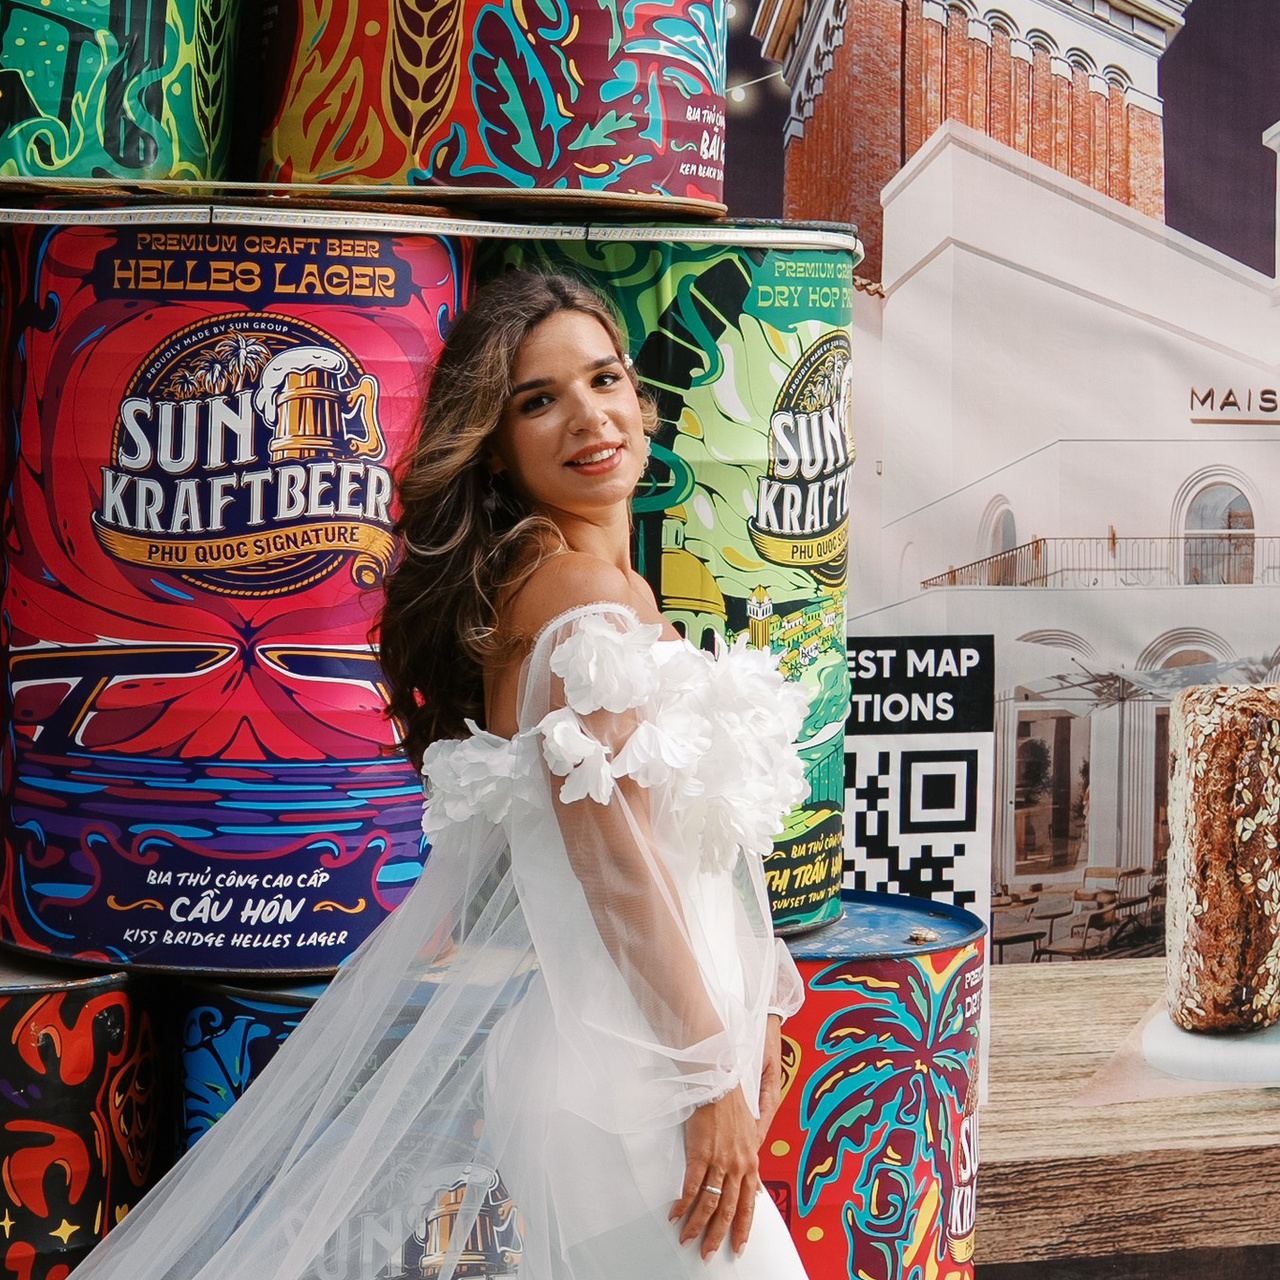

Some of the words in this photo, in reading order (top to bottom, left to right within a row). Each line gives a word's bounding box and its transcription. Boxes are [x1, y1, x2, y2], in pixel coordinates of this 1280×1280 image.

[686, 105, 700, 122] BIA
[680, 163, 697, 176] KEM
[137, 233, 238, 253] PREMIUM
[244, 235, 319, 256] CRAFT
[326, 237, 381, 259] BEER
[113, 259, 262, 293] HELLES
[273, 263, 397, 299] LAGER
[774, 262, 834, 278] PREMIUM
[757, 285, 803, 308] DRY
[808, 286, 840, 308] HOP
[146, 344, 181, 380] PROUDLY
[183, 330, 211, 347] MADE
[213, 324, 226, 334] BY
[229, 321, 250, 330] SUN
[253, 321, 289, 333] GROUP
[789, 362, 811, 395] PROUDLY
[810, 348, 824, 364] MADE
[119, 388, 260, 474] SUN
[771, 401, 846, 480] SUN
[99, 460, 393, 535] KRAFTBEER
[147, 542, 189, 564] PHU
[194, 538, 249, 563] QUOC
[253, 526, 360, 558] SIGNATURE
[791, 545, 813, 559] PHU
[817, 536, 837, 558] QUOC
[907, 648, 980, 678] MAP
[791, 843, 806, 858] BIA
[147, 870, 173, 885] BIA
[176, 867, 212, 888] THỦ
[215, 870, 260, 889] CÔNG
[262, 872, 294, 888] CAO
[298, 867, 329, 888] CẤP
[793, 853, 829, 889] TRẤN
[169, 889, 231, 923] CẦU
[241, 896, 306, 924] HÔN
[772, 895, 806, 911] SUNSET
[809, 888, 826, 903] TOWN
[123, 928, 158, 943] KISS
[162, 930, 227, 948] BRIDGE
[230, 931, 291, 948] HELLES
[296, 930, 348, 948] LAGER
